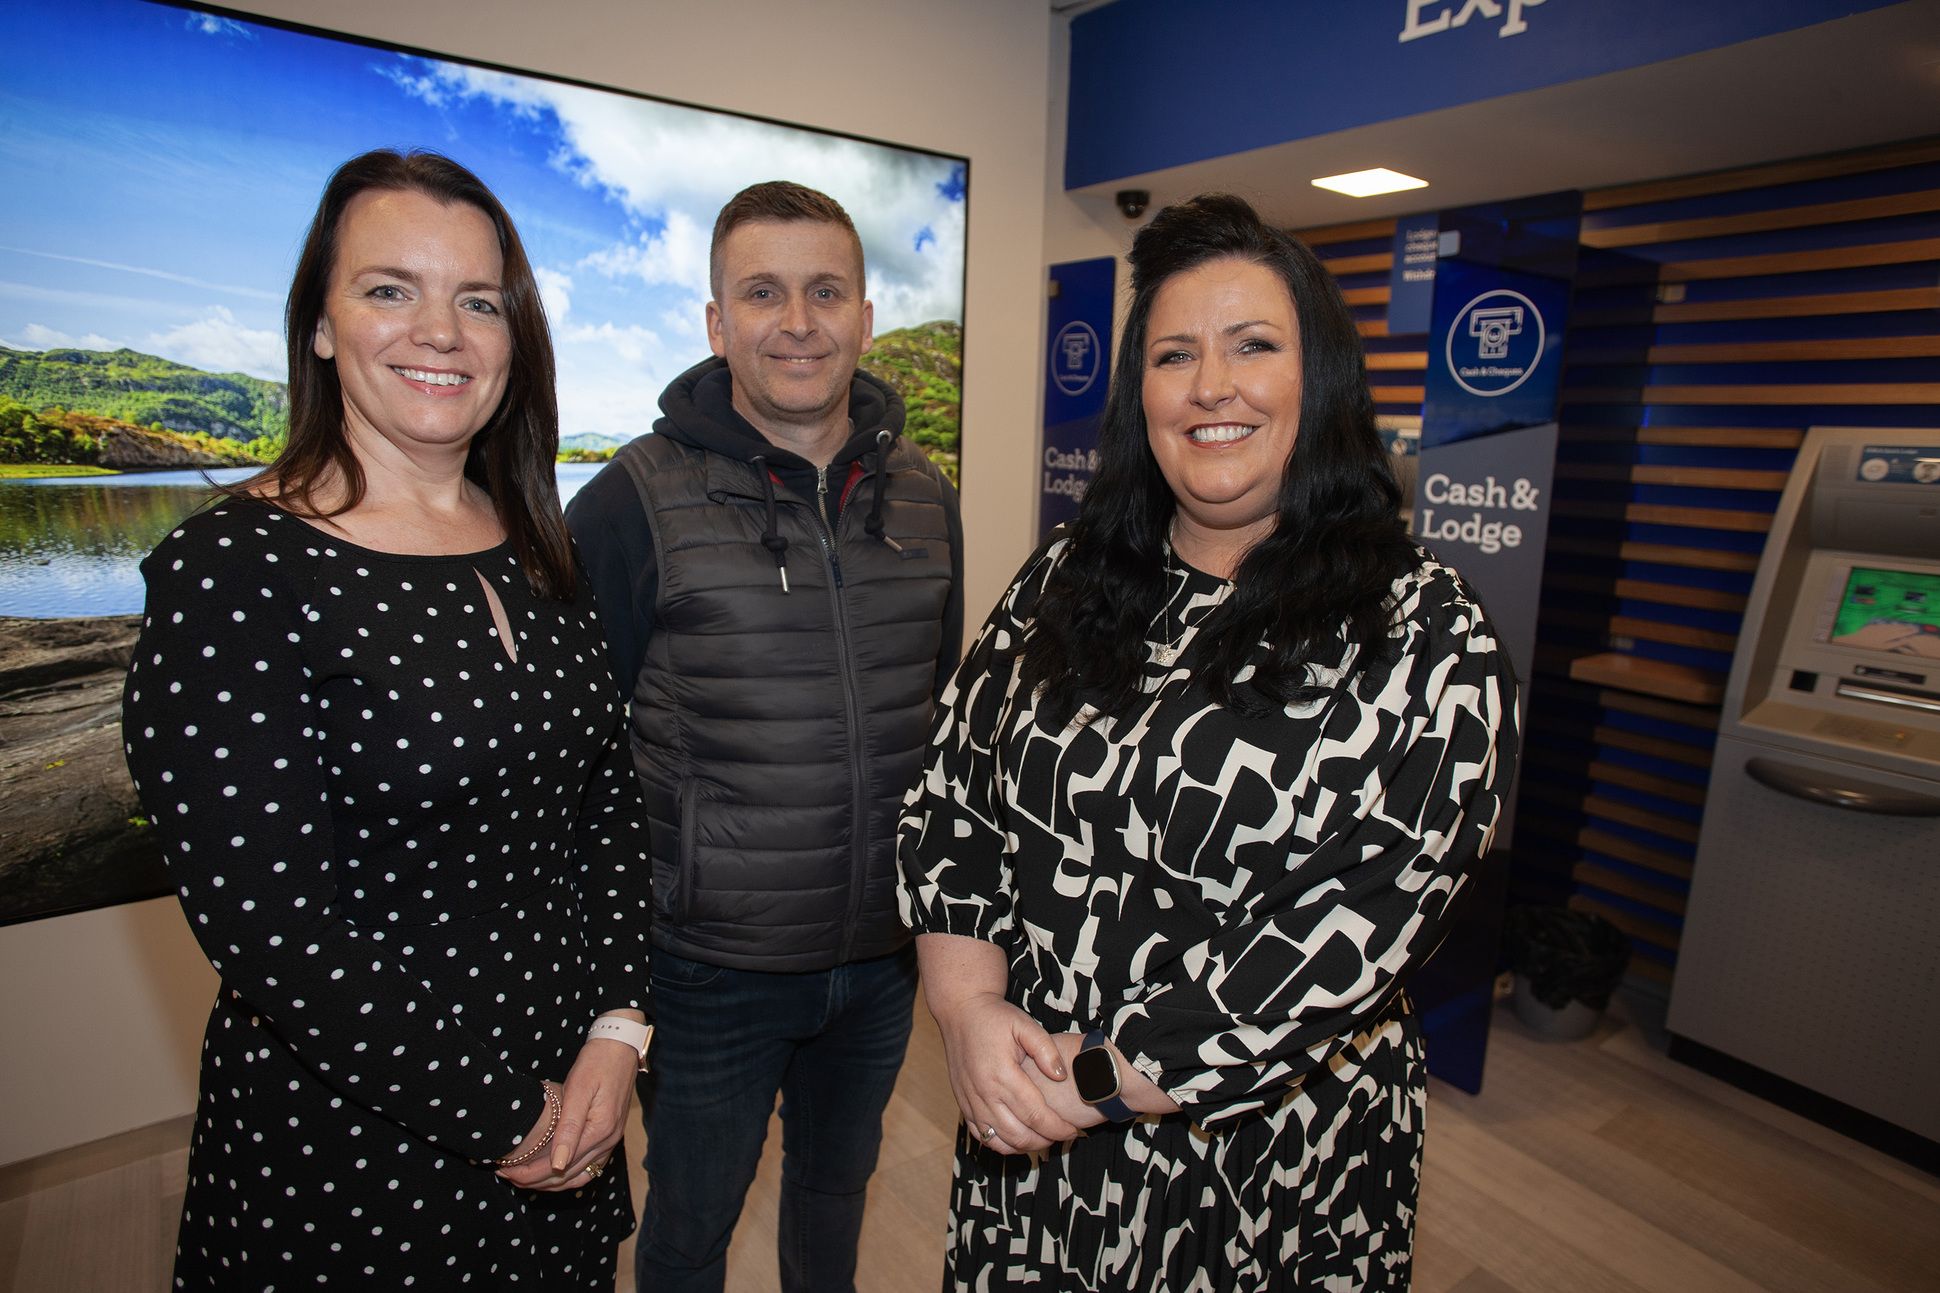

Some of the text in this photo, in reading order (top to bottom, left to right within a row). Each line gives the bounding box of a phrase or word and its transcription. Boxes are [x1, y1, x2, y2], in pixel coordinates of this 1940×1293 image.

[1044, 446, 1087, 469] Cash
[1043, 471, 1087, 503] Lodg
[1424, 473, 1540, 511] Cash &
[1421, 509, 1523, 554] Lodge
